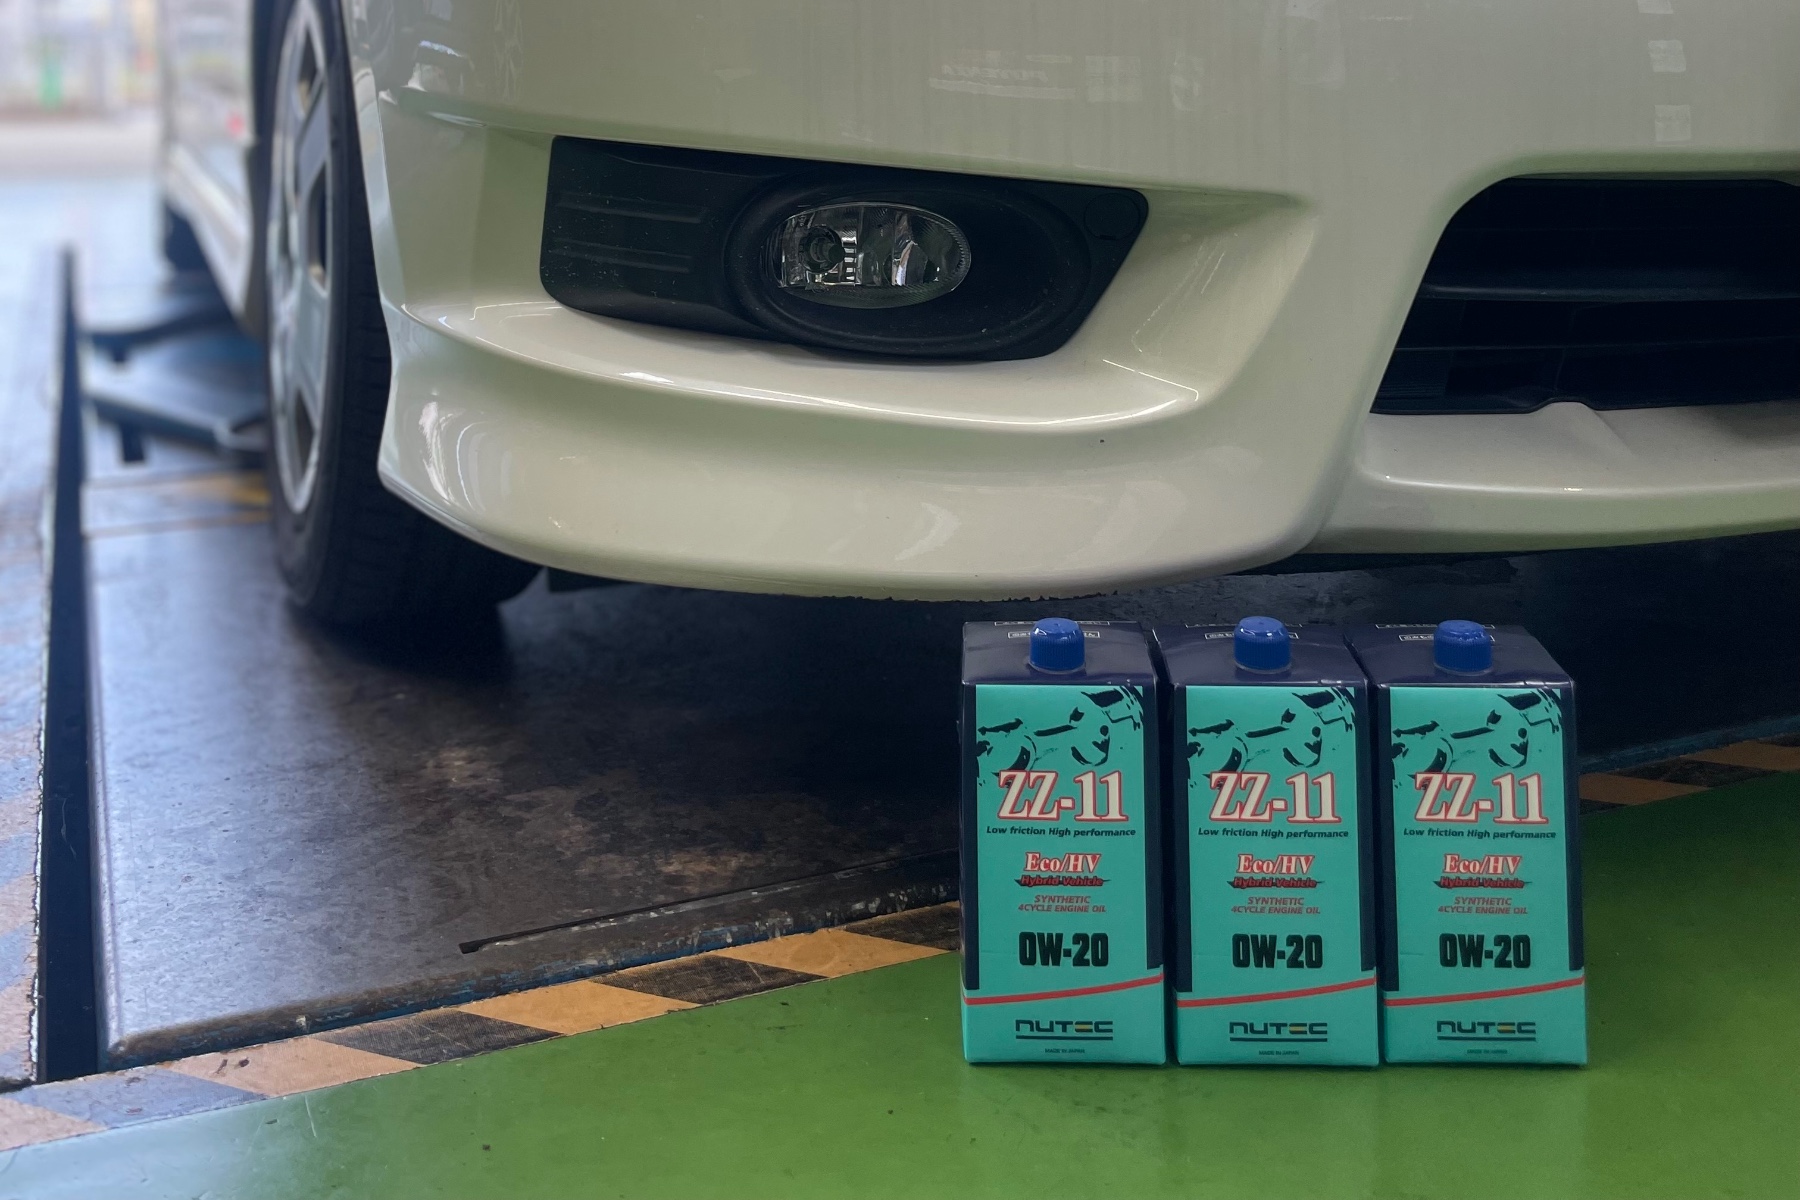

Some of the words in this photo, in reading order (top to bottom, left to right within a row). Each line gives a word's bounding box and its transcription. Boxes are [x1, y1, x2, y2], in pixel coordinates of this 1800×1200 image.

[997, 770, 1129, 822] ZZ-11
[1209, 771, 1341, 823] ZZ-11
[1414, 772, 1549, 824] ZZ-11
[986, 826, 1007, 834] Low
[1010, 827, 1045, 835] friction
[1049, 827, 1071, 837] High
[1074, 828, 1136, 838] performance
[1198, 828, 1219, 836] Low
[1222, 828, 1258, 836] friction
[1261, 829, 1284, 839] High
[1286, 830, 1349, 839] performance
[1404, 828, 1424, 836] Low
[1428, 828, 1464, 837] friction
[1467, 829, 1490, 839] High
[1493, 830, 1556, 839] performance
[1023, 852, 1101, 873] Eco/HV
[1237, 854, 1315, 874] Eco/HV
[1443, 854, 1522, 875] Eco/HV
[1020, 875, 1060, 887] Hybrid
[1061, 875, 1104, 886] Vehicle
[1233, 877, 1273, 889] Hybrid
[1275, 877, 1317, 888] Vehicle
[1440, 876, 1480, 888] Hybrid
[1482, 877, 1524, 888] Vehicle
[1034, 895, 1091, 903] SYNTHETIC
[1248, 897, 1304, 905] SYNTHETIC
[1455, 897, 1512, 905] SYNTHETIC
[1018, 904, 1052, 912] 4CYCLE
[1268, 906, 1303, 914] ENGINE
[1019, 932, 1109, 967] 0W-20
[1232, 934, 1323, 968] 0W-20
[1439, 933, 1531, 968] 0W-20
